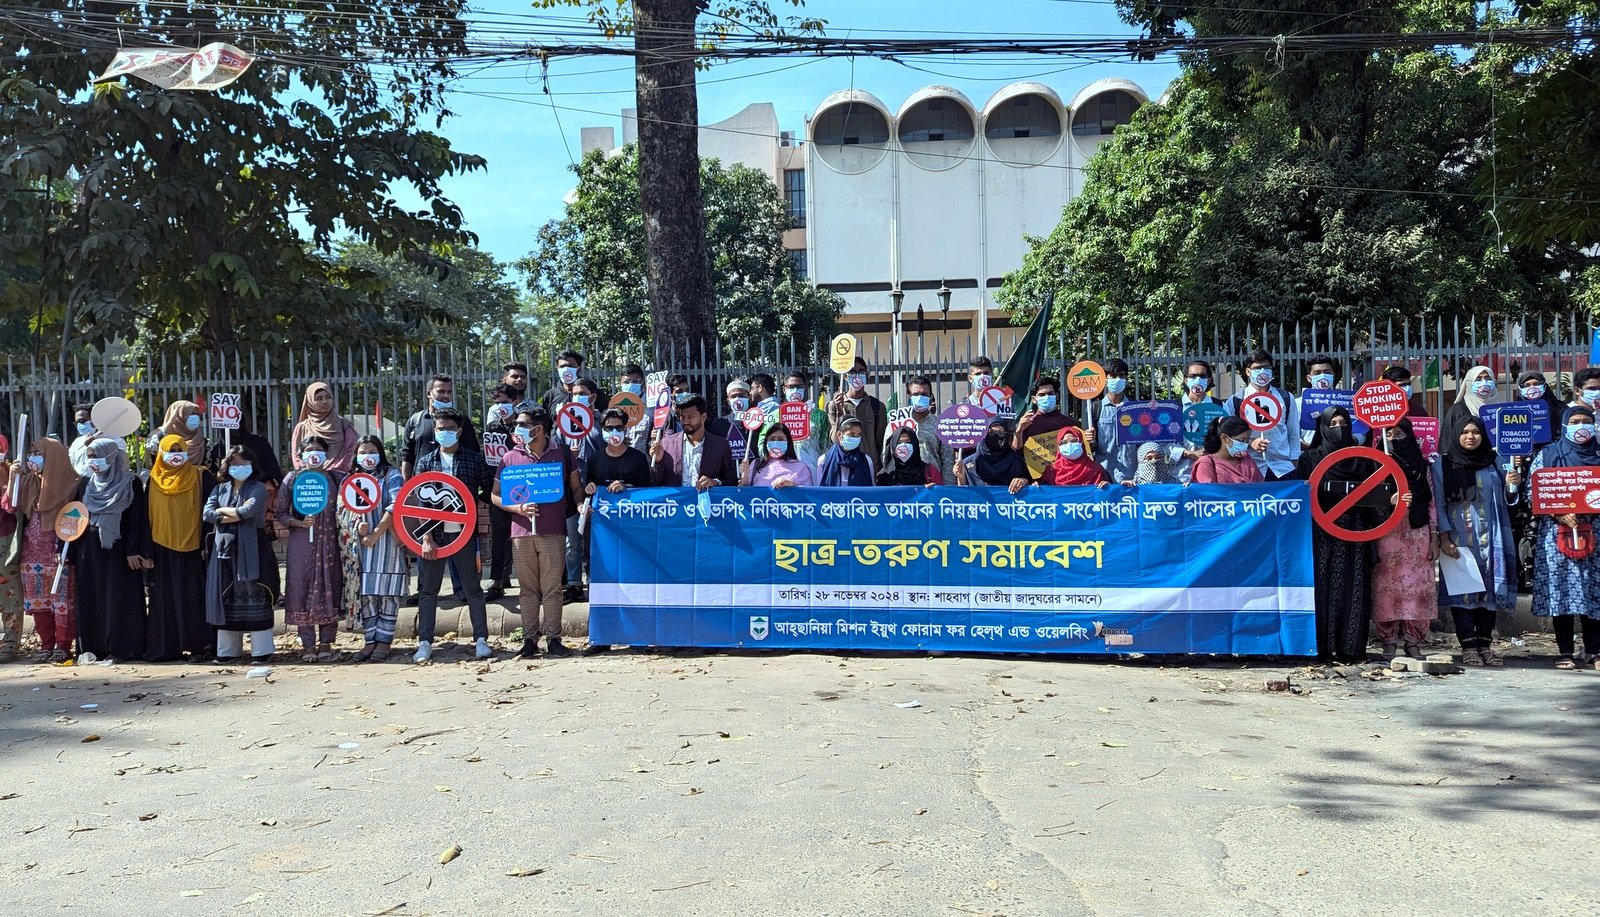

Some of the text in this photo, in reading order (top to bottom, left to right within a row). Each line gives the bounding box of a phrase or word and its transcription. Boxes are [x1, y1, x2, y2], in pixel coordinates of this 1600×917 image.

[648, 372, 666, 384] SAY
[1072, 376, 1100, 387] DAM
[1077, 386, 1097, 394] HEALTH
[1366, 384, 1391, 394] STOP
[213, 394, 238, 405] SAY
[1358, 392, 1402, 406] SMOKING
[212, 406, 238, 419] NO
[890, 407, 912, 421] SAY
[1362, 402, 1402, 414] in Public
[734, 412, 774, 423] TOBACCO
[1370, 414, 1395, 423] Place
[1504, 414, 1527, 424] BAN
[484, 434, 506, 444] SAY
[485, 444, 507, 457] NO
[598, 498, 679, 520] ই-সিগারেট
[684, 504, 696, 518] ও
[750, 498, 816, 520] নিষিদ্ধসহ
[820, 498, 880, 520] প্রস্তাবিত
[884, 501, 935, 520] তামাক
[939, 497, 991, 520] নিয়ন্ত্রণ
[996, 498, 1058, 521] আইনের
[1062, 496, 1140, 520] সংশোধনী
[1143, 502, 1179, 520] দ্রুত
[1184, 498, 1237, 518] পাসের
[1241, 494, 1303, 516] দাবিতে
[773, 539, 1104, 573] ছাত্র-তরুণ সমাবেশ
[778, 588, 1102, 607] তারিখ: ২৮ নভেম্বর ২০২৪ স্থান: শাহবাগ (জাতীয় জাদুঘরের সামনে)
[836, 619, 867, 635] মিশন
[870, 620, 898, 639] ইয়ুথ
[902, 622, 942, 636] ফোরাম
[945, 624, 966, 637] ফর
[1009, 626, 1030, 638] এন্ড
[1034, 623, 1090, 640] ওয়েলবিং
